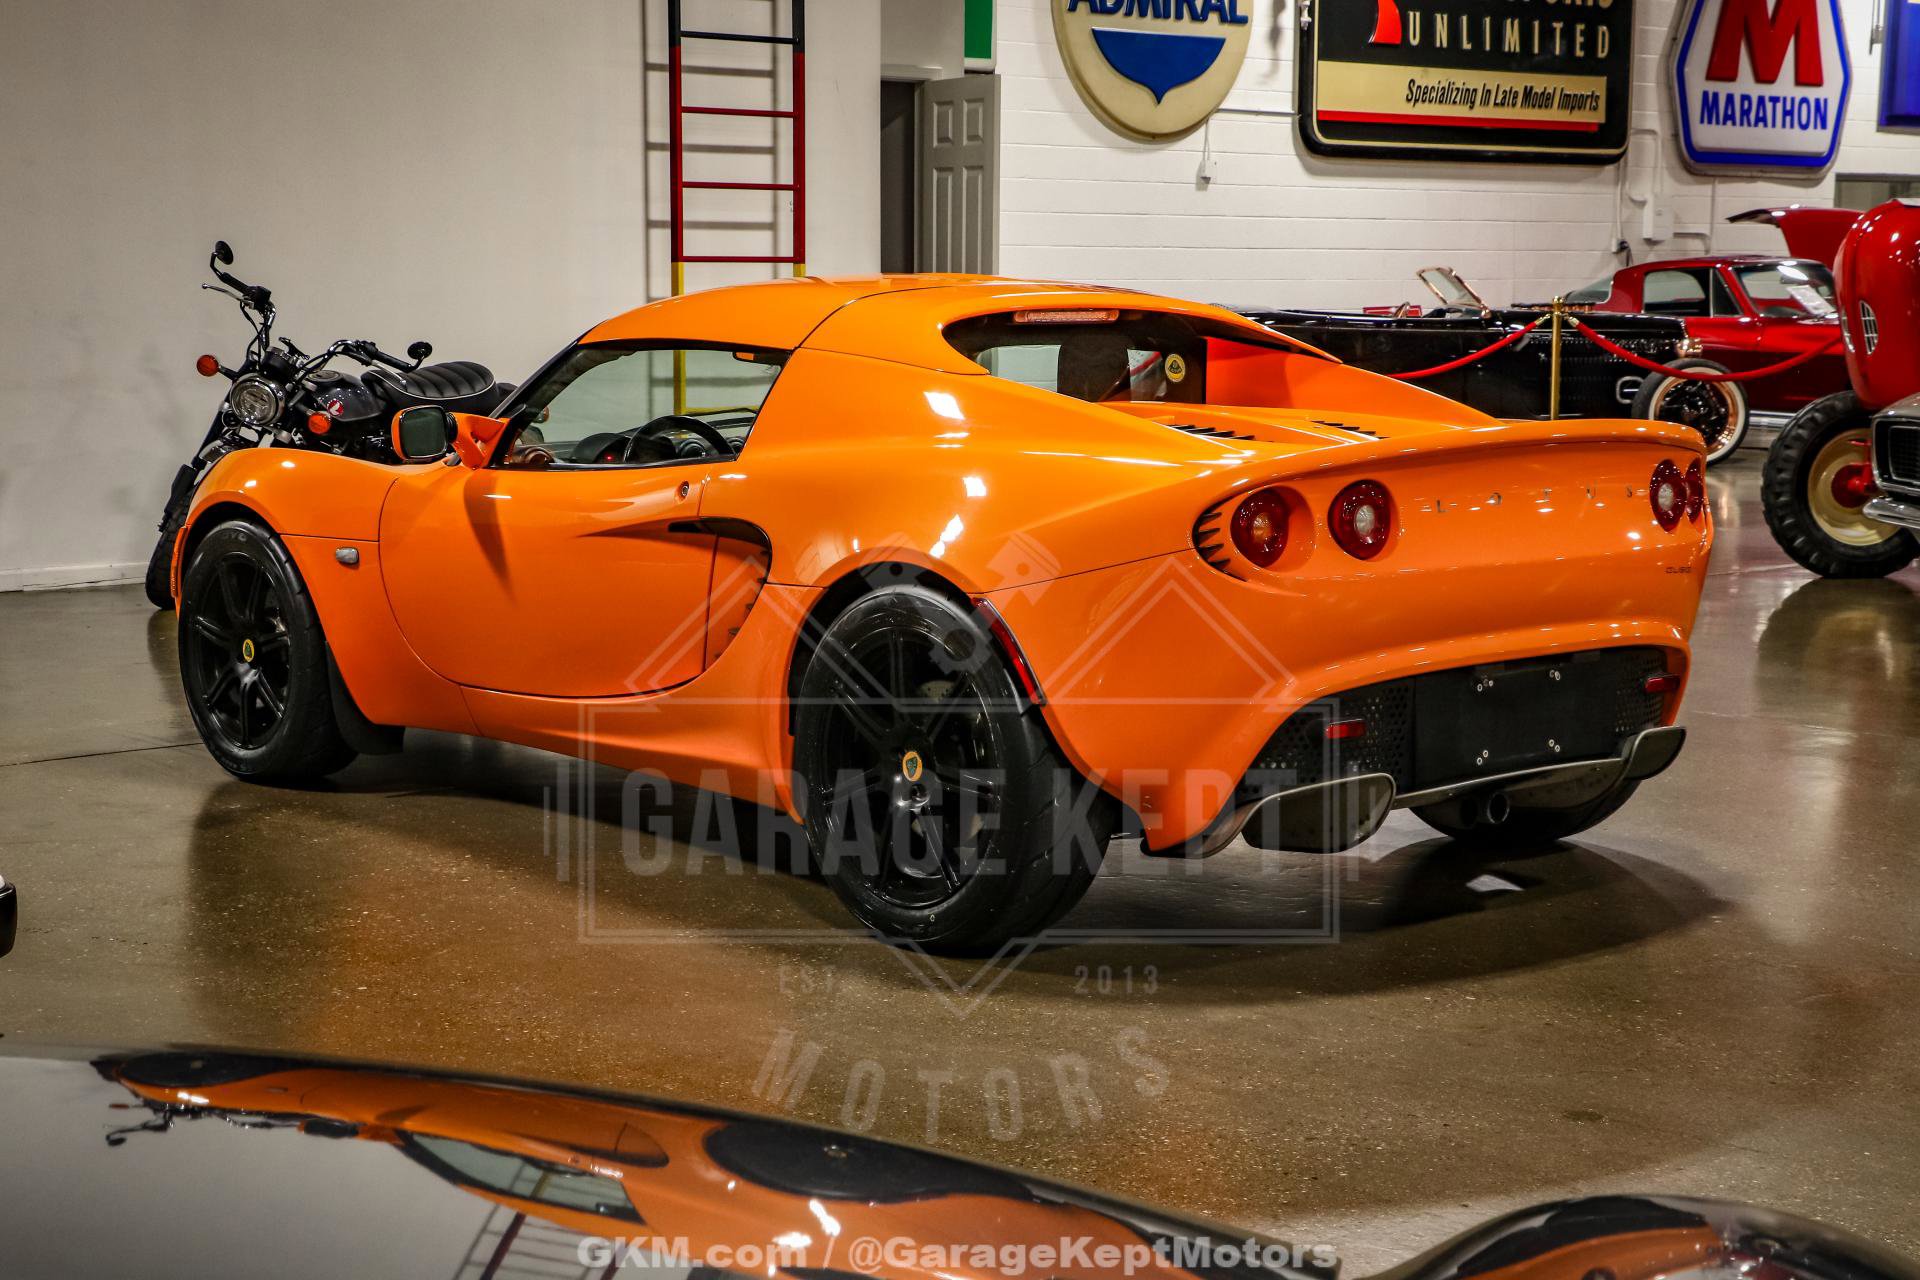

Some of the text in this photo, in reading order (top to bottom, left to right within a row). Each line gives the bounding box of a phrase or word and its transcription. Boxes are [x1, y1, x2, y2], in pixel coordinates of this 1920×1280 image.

[1067, 0, 1249, 24] MIRAL
[1407, 10, 1610, 58] UNLIMITED
[1705, 0, 1824, 87] M
[1405, 78, 1600, 115] Specializing In Late Model Imports
[1700, 90, 1828, 131] MARATHON
